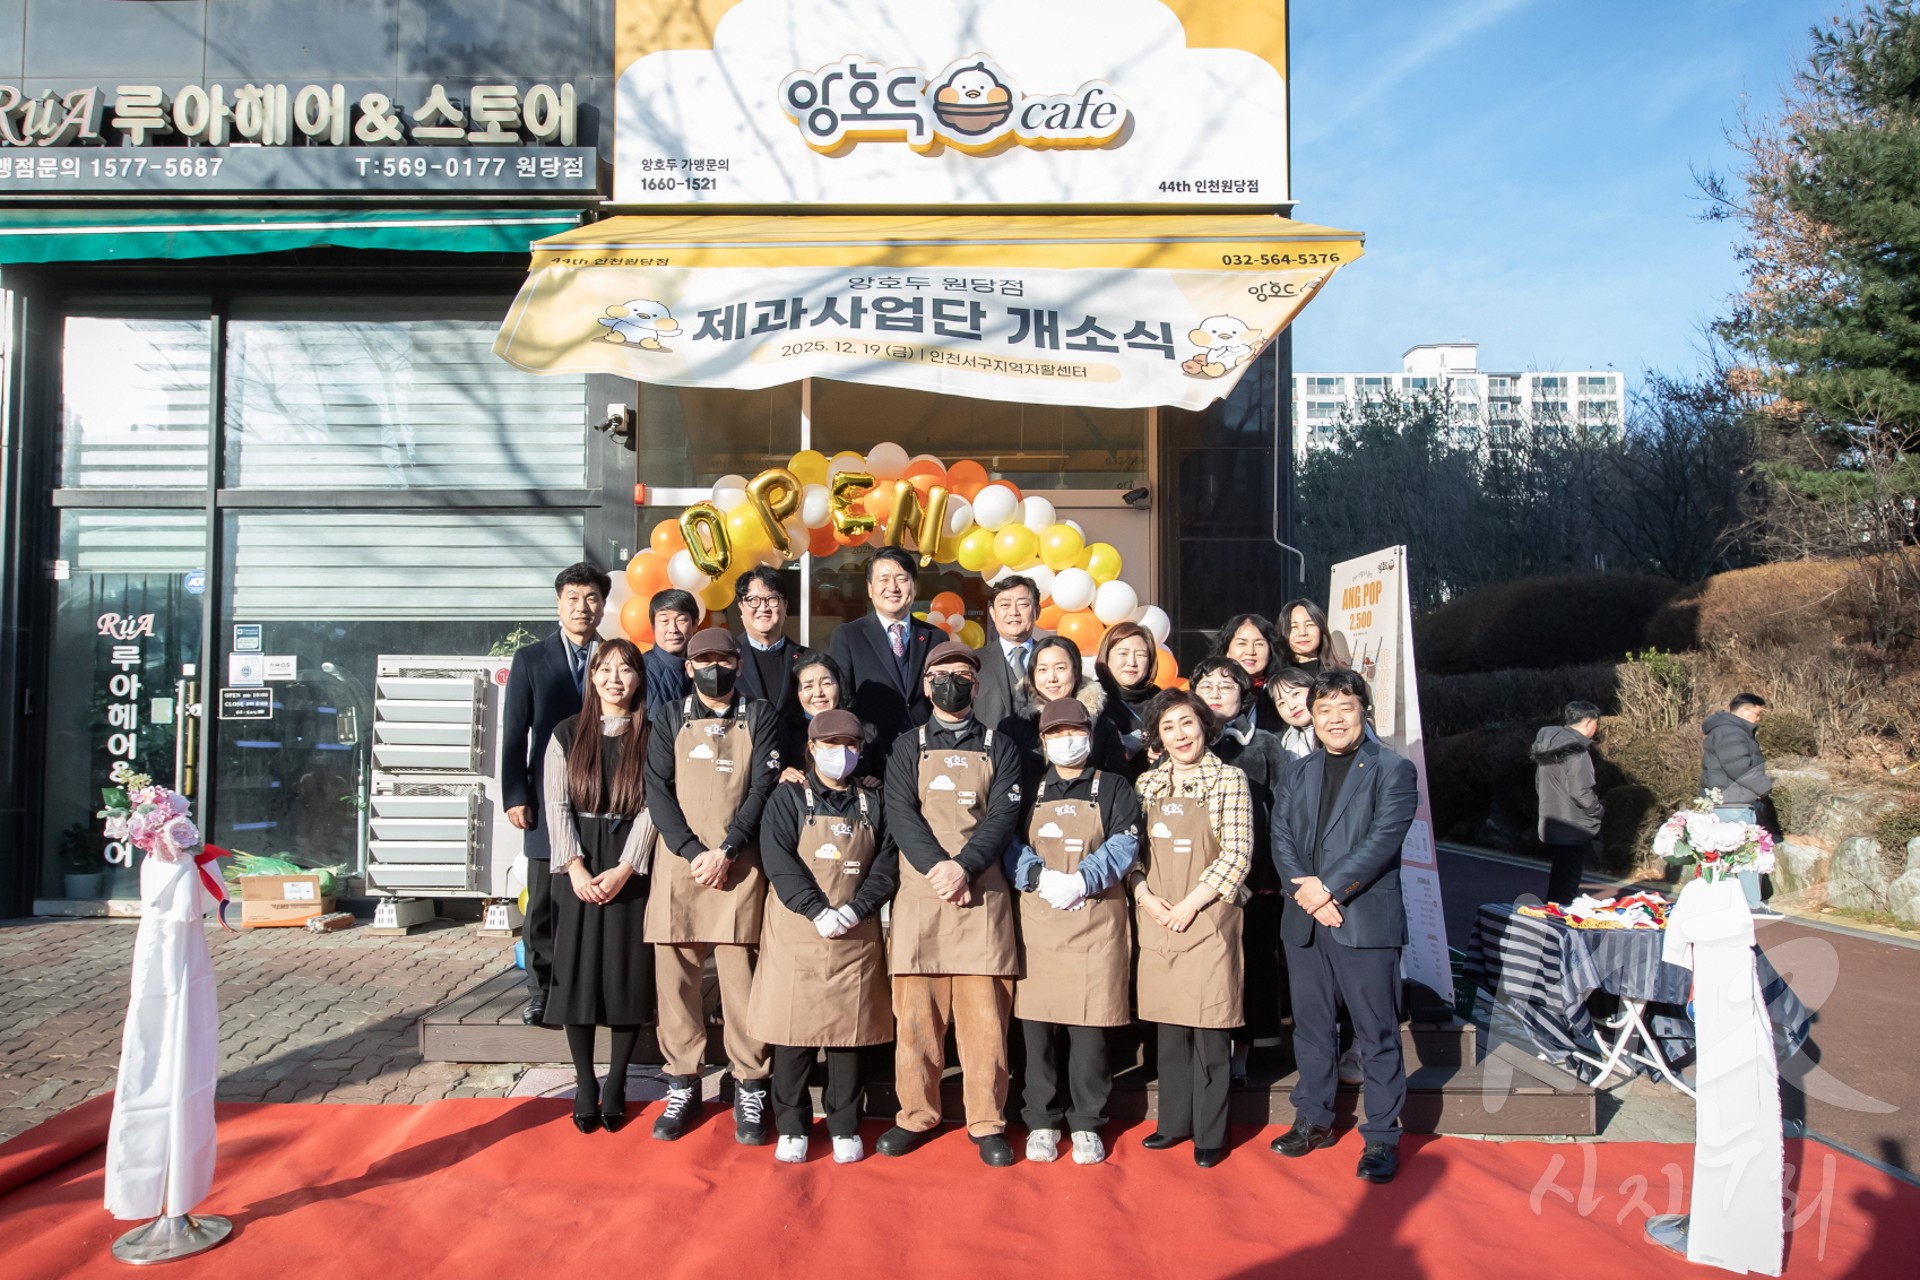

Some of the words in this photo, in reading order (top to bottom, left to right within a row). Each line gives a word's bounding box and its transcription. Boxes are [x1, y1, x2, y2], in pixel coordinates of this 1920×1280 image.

[787, 64, 924, 136] 앙호두
[1020, 88, 1117, 130] cafe
[90, 157, 224, 178] 1577-5687
[355, 157, 507, 177] T:569-0177
[516, 156, 584, 178] 원당점
[641, 158, 678, 172] 앙호두
[681, 158, 729, 172] 가맹문의
[641, 177, 717, 191] 1660-1521
[1158, 180, 1191, 192] 44th
[1194, 179, 1259, 193] 인천원당점
[1221, 252, 1341, 266] 032-564-5376
[848, 276, 932, 291] 앙호두
[941, 276, 1024, 297] 원당점
[692, 295, 987, 341] 제과사업단
[1007, 306, 1176, 360] 개소식
[781, 340, 829, 358] 2025.
[836, 341, 857, 354] 12.
[929, 350, 1088, 379] 인천서구지역자활센터
[679, 466, 949, 582] OPEN
[1342, 584, 1362, 611] ANG
[1363, 580, 1383, 607] POP
